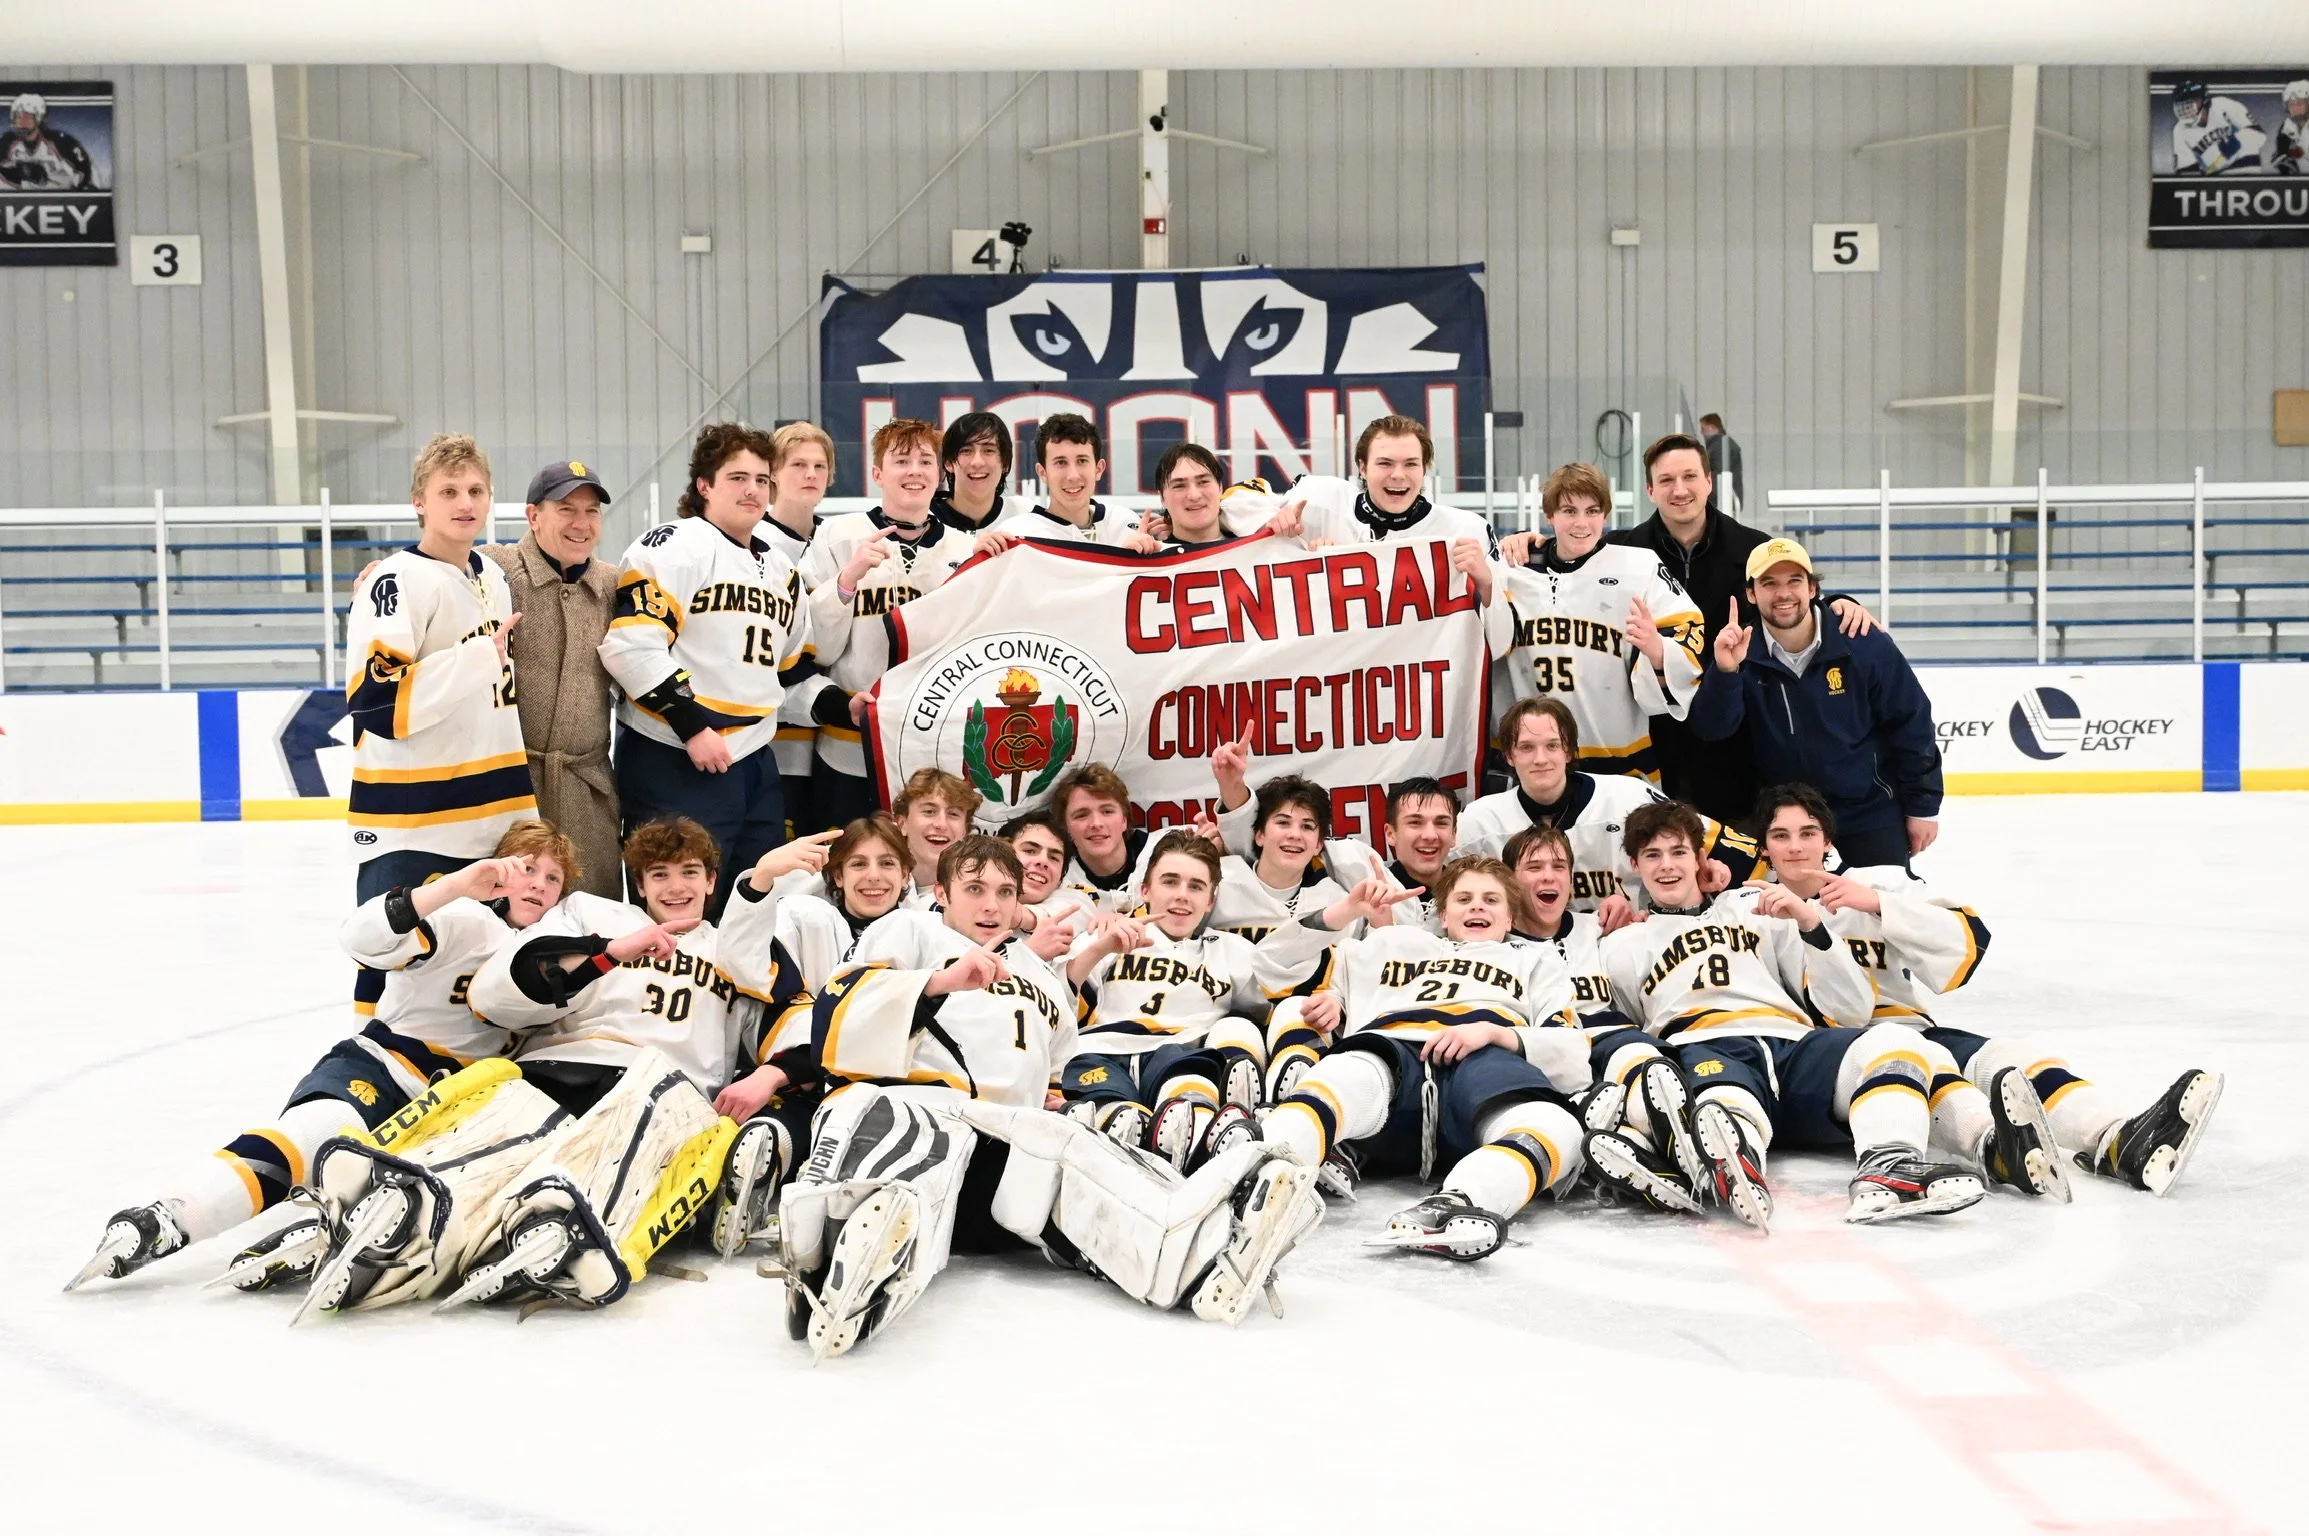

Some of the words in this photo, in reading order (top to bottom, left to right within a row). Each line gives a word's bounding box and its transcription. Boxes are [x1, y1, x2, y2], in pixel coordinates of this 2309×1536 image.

[0, 205, 98, 235] KEY
[153, 243, 179, 278] 3
[971, 238, 1001, 271] 4
[1833, 231, 1859, 264] 5
[1125, 540, 1478, 654] CENTRAL
[742, 625, 776, 668] 15
[913, 653, 983, 731] CENTRAL
[984, 640, 1119, 717] CONNECTICUT
[1533, 656, 1575, 693] 35
[1148, 659, 1450, 760] CONNECTICUT
[1935, 720, 1994, 737] CKEY
[2084, 719, 2174, 735] HOCKEY
[2080, 736, 2136, 751] EAST
[1380, 958, 1524, 1002] SIMSBURY
[1415, 979, 1461, 1002] 21
[641, 983, 692, 1023] 30
[1014, 1008, 1027, 1050] 1
[371, 1089, 442, 1146] CCM
[648, 1177, 710, 1249] CCM
